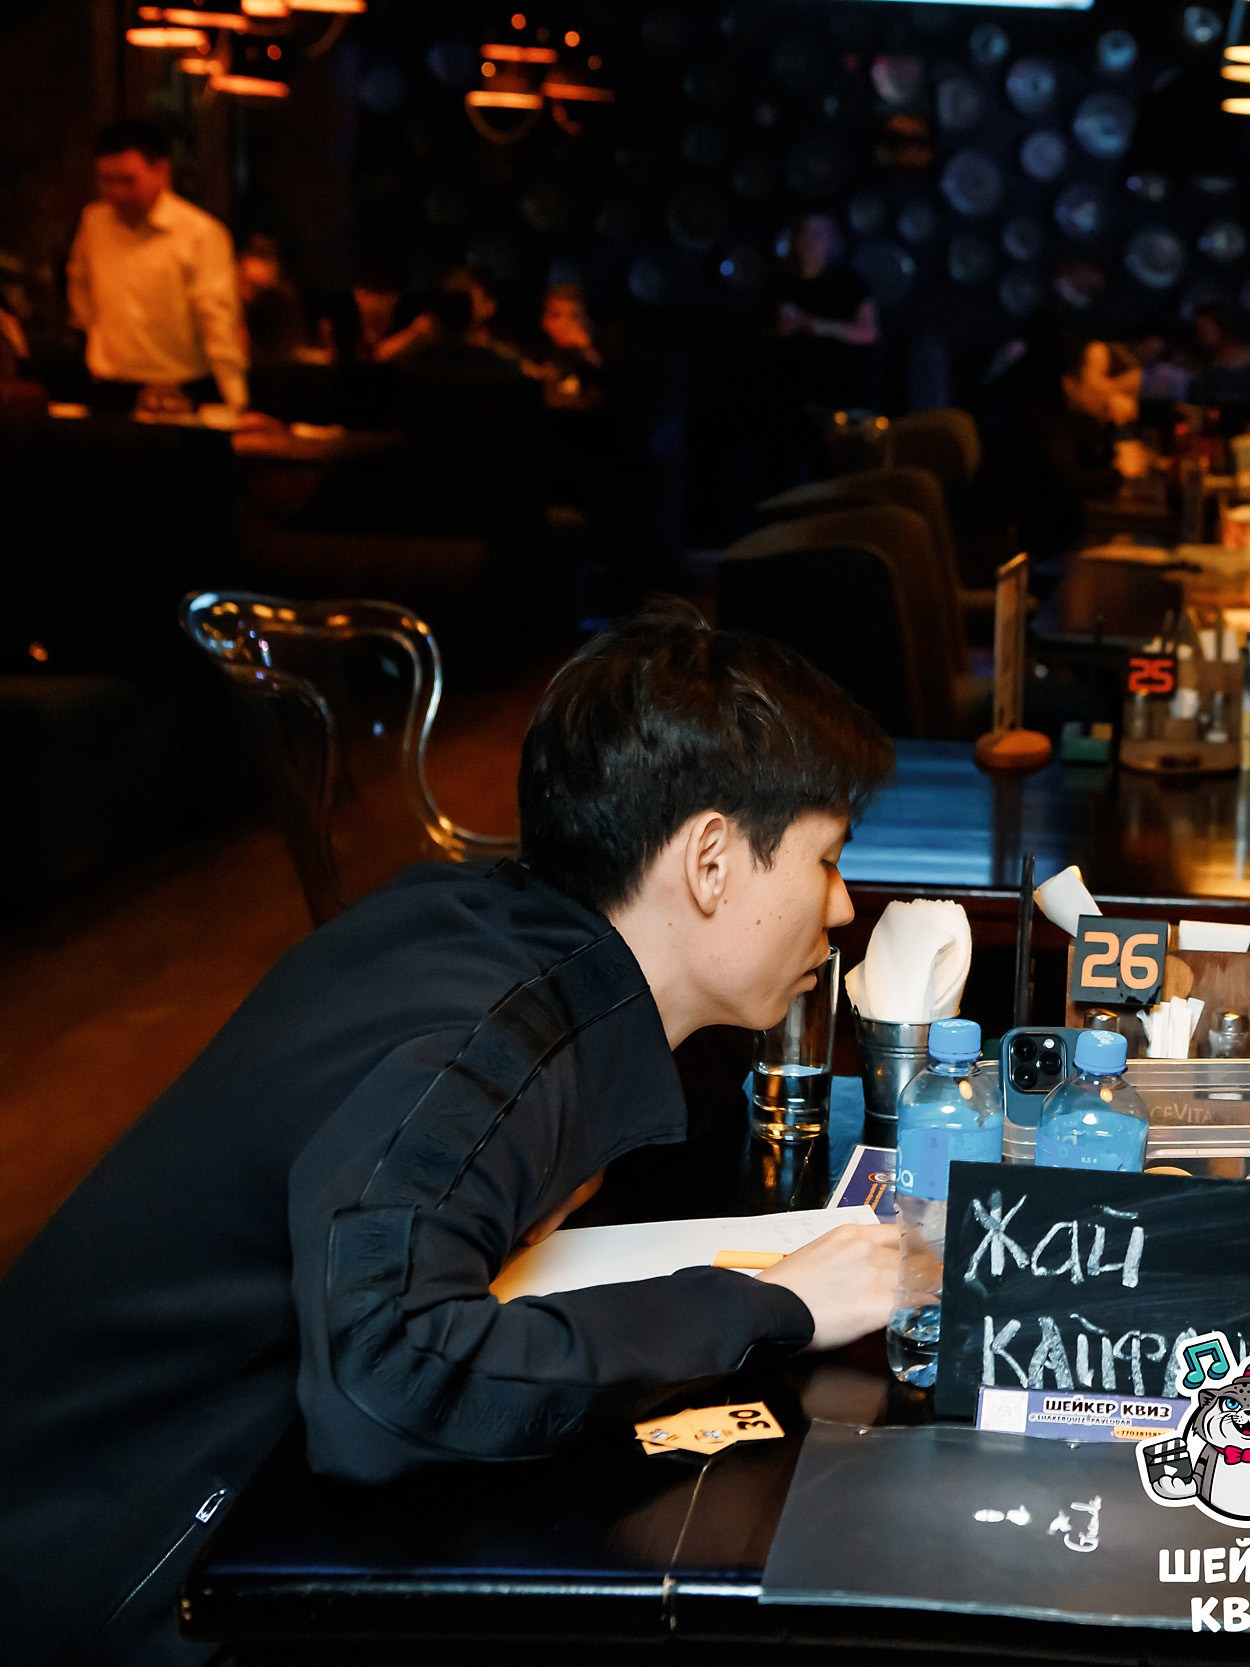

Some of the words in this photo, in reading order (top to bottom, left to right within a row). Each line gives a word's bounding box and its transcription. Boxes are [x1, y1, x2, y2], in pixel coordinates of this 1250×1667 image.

[1128, 658, 1174, 693] 25
[1081, 930, 1160, 990] 26
[729, 1409, 771, 1431] 30
[1045, 1397, 1117, 1414] ШЕЙКЕР
[1123, 1404, 1170, 1418] КВИЗ
